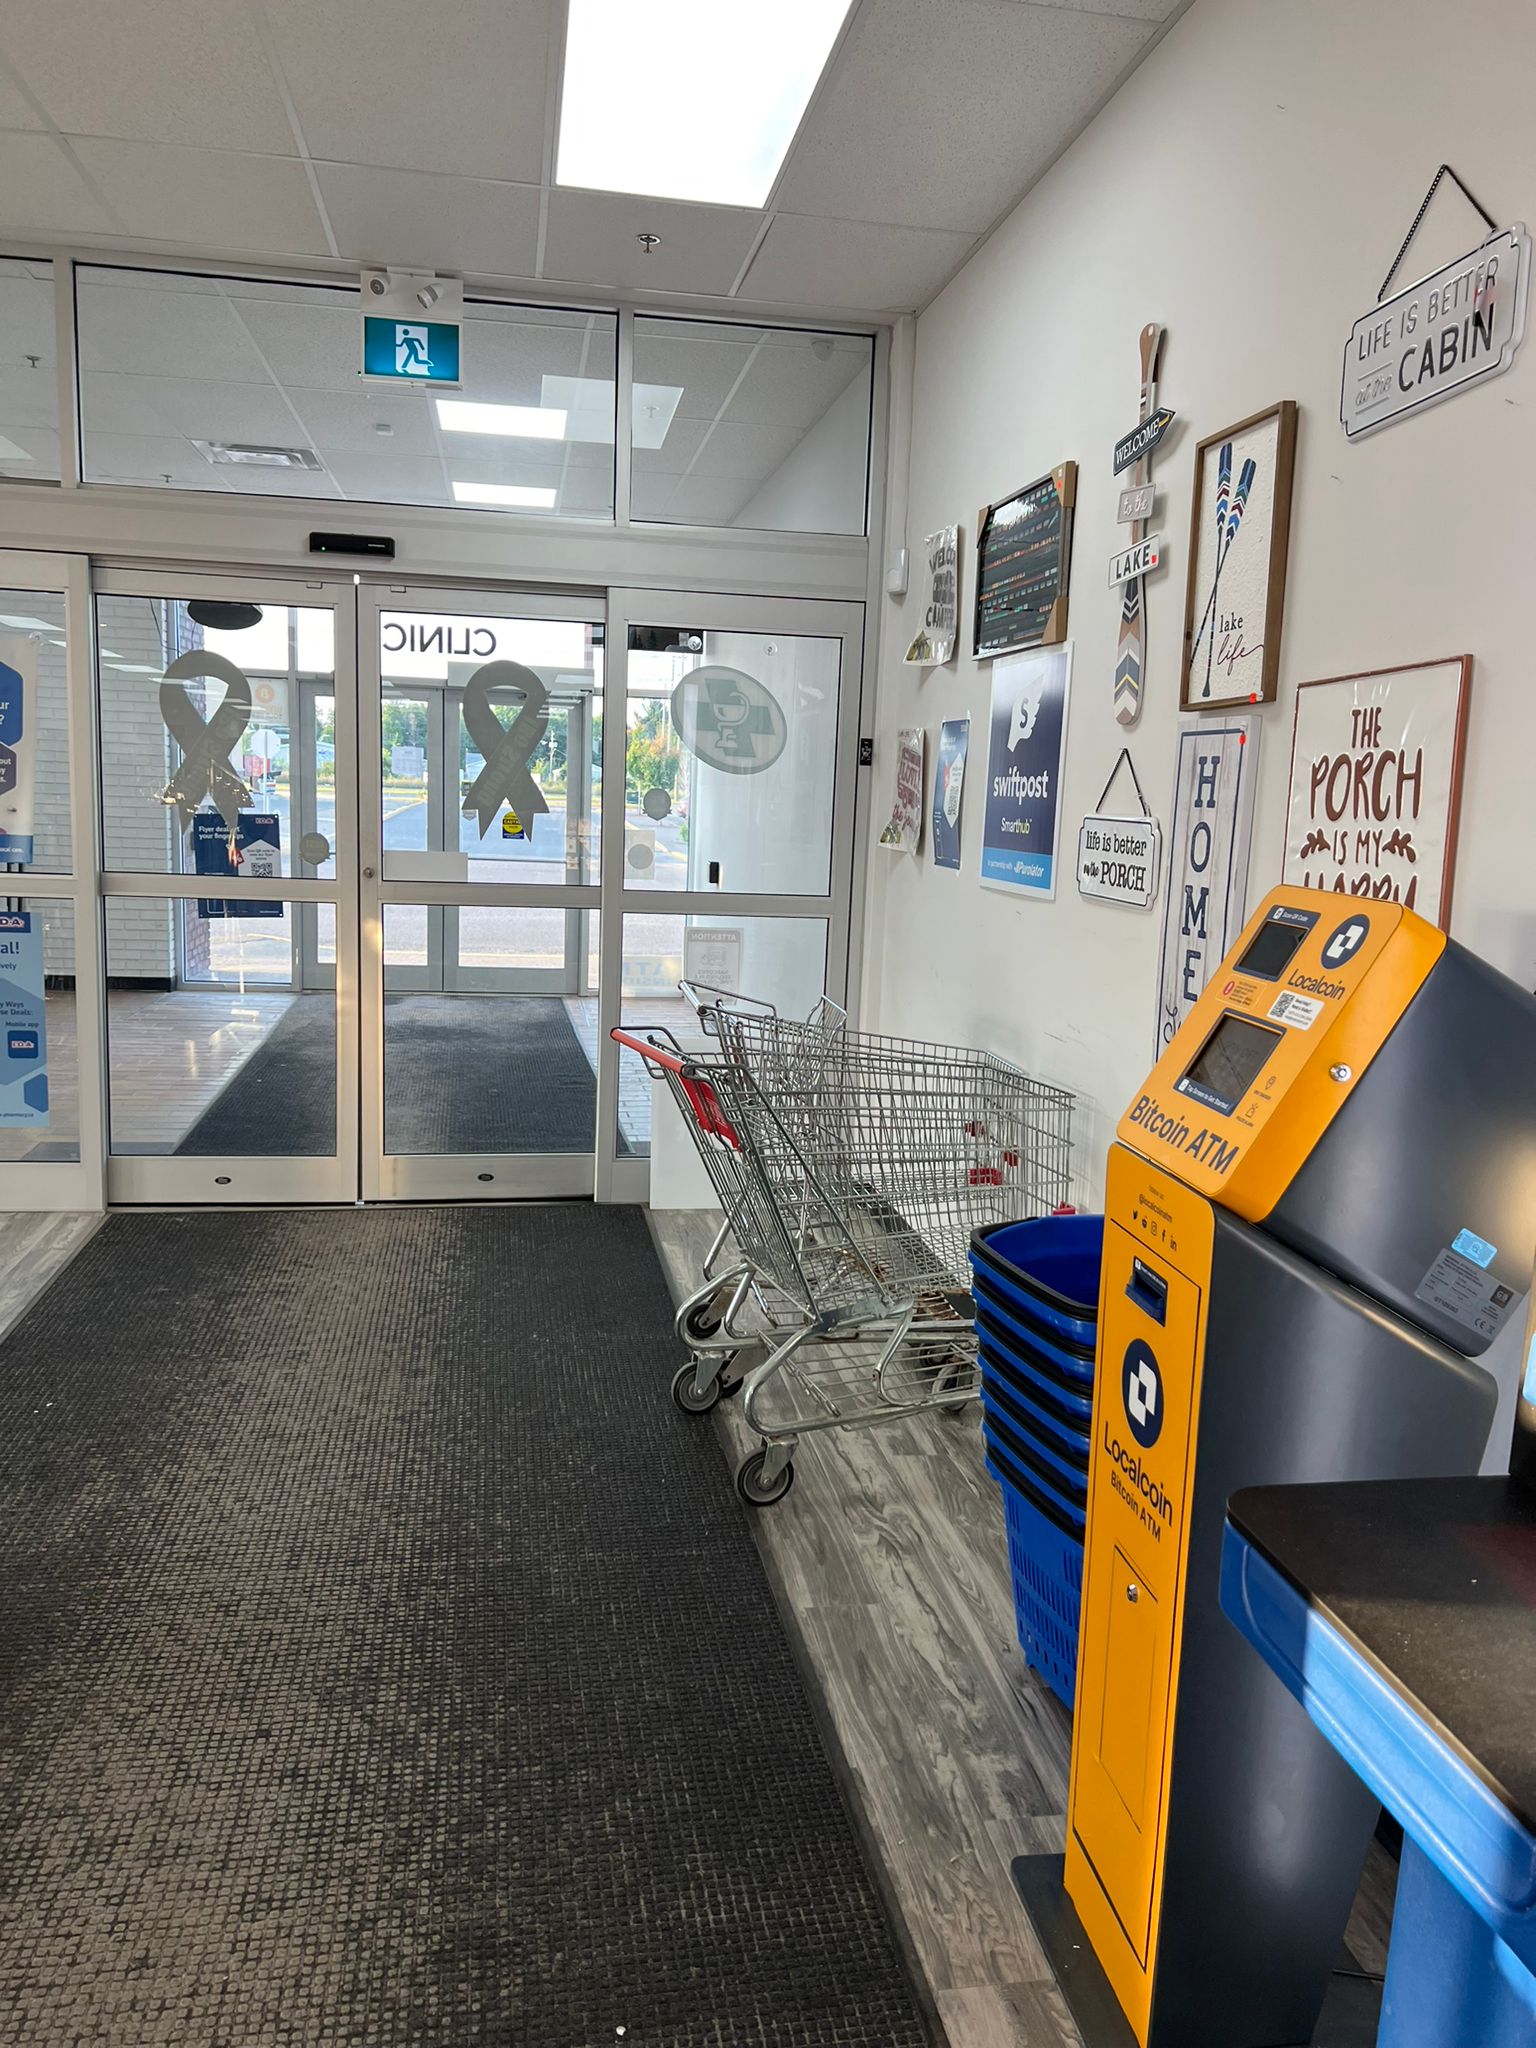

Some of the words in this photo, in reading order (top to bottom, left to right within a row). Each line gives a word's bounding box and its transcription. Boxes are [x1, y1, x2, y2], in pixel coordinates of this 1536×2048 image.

[1358, 315, 1393, 361] LIFE
[1400, 300, 1419, 339] IS
[1427, 254, 1499, 324] BETTER
[1398, 302, 1496, 392] CABIN
[1115, 418, 1161, 465] WELCOME
[1123, 499, 1134, 516] to
[1134, 491, 1149, 512] the
[1115, 544, 1151, 580] LAKE
[1218, 613, 1245, 634] lake
[1217, 634, 1265, 676] life
[1351, 706, 1383, 749] THE
[993, 765, 1049, 806] swiftpost
[1309, 747, 1424, 822] PORCH
[198, 825, 214, 835] Flyer
[1085, 830, 1101, 852] life
[1102, 833, 1112, 853] is
[1113, 833, 1147, 857] better
[1332, 829, 1349, 866] IS
[1355, 829, 1384, 868] MY
[1100, 860, 1147, 892] PORCH
[1181, 755, 1221, 1003] HOME
[1287, 968, 1346, 1001] Localcoin
[1129, 1095, 1191, 1150] Bitcoin
[1184, 1128, 1240, 1176] ATM
[1103, 1420, 1173, 1528] Localcoin
[1110, 1469, 1139, 1517] Bitcoin
[1139, 1506, 1161, 1544] ATM
